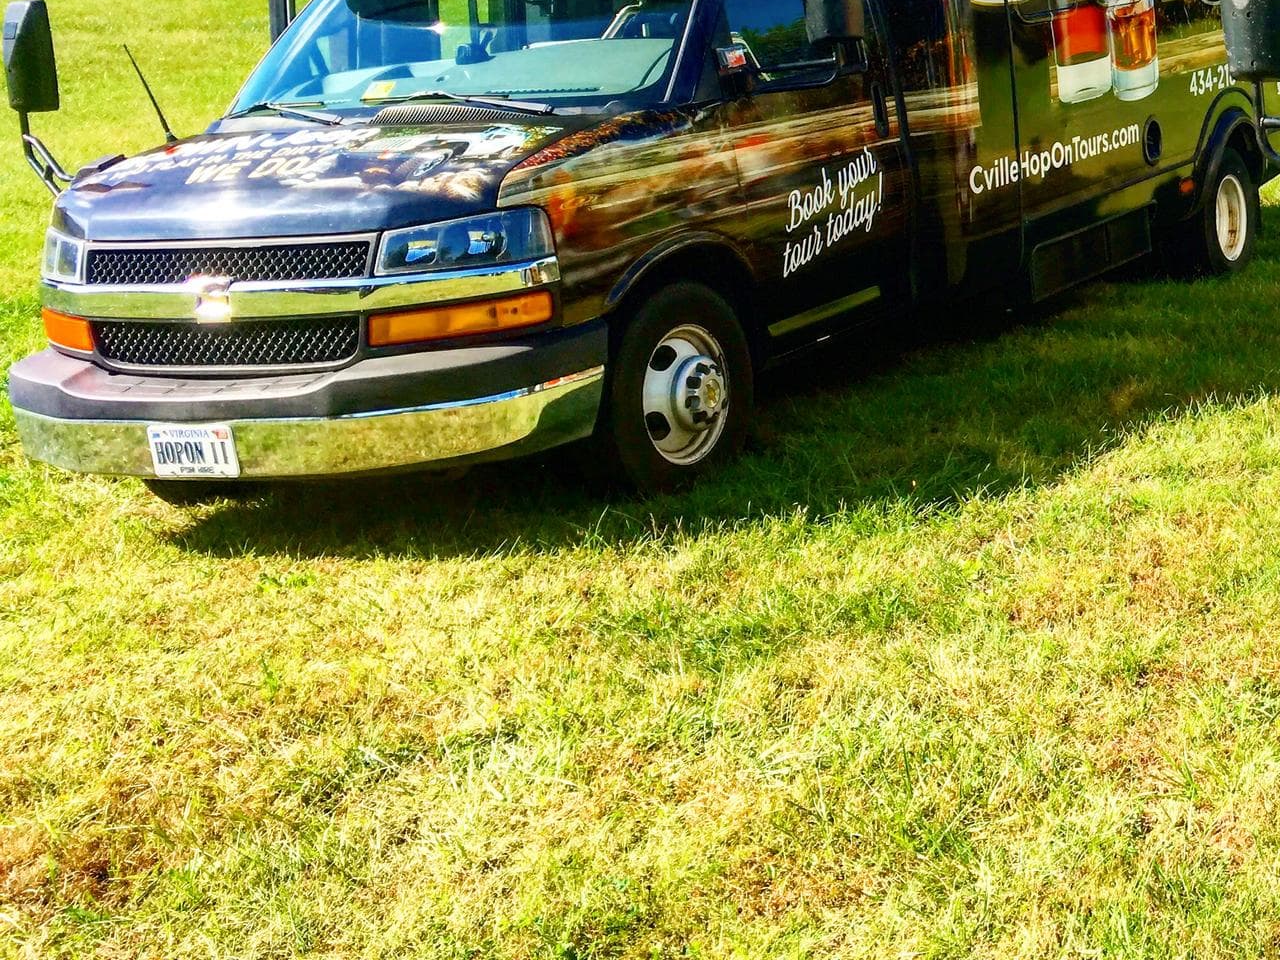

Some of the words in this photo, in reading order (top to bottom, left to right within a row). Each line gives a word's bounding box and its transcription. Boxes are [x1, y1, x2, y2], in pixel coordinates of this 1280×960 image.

[185, 160, 252, 184] WE
[969, 122, 1140, 195] CvilleHopOnTours.com
[786, 177, 836, 233] Book
[837, 146, 878, 208] your
[782, 221, 823, 278] tour
[826, 171, 884, 247] today!
[155, 441, 205, 464] HOPON
[169, 429, 210, 438] VIRGINIA
